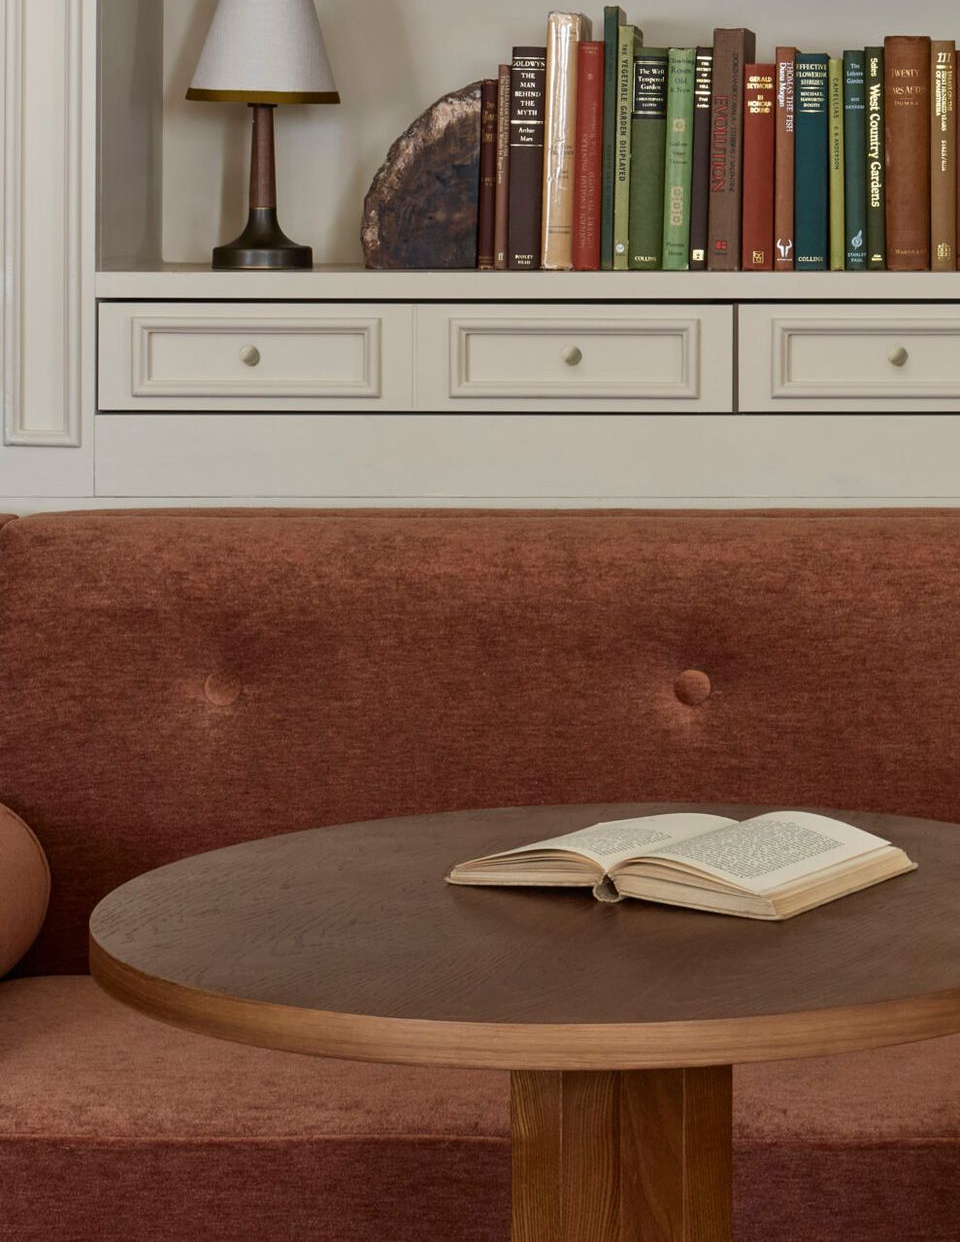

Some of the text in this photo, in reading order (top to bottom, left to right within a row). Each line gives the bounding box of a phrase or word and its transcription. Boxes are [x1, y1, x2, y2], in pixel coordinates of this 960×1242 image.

[620, 59, 628, 102] VEGETABLE
[619, 140, 627, 182] DISPLAYED
[712, 95, 728, 193] EVOLUTION
[868, 84, 881, 207] West Country Gardens
